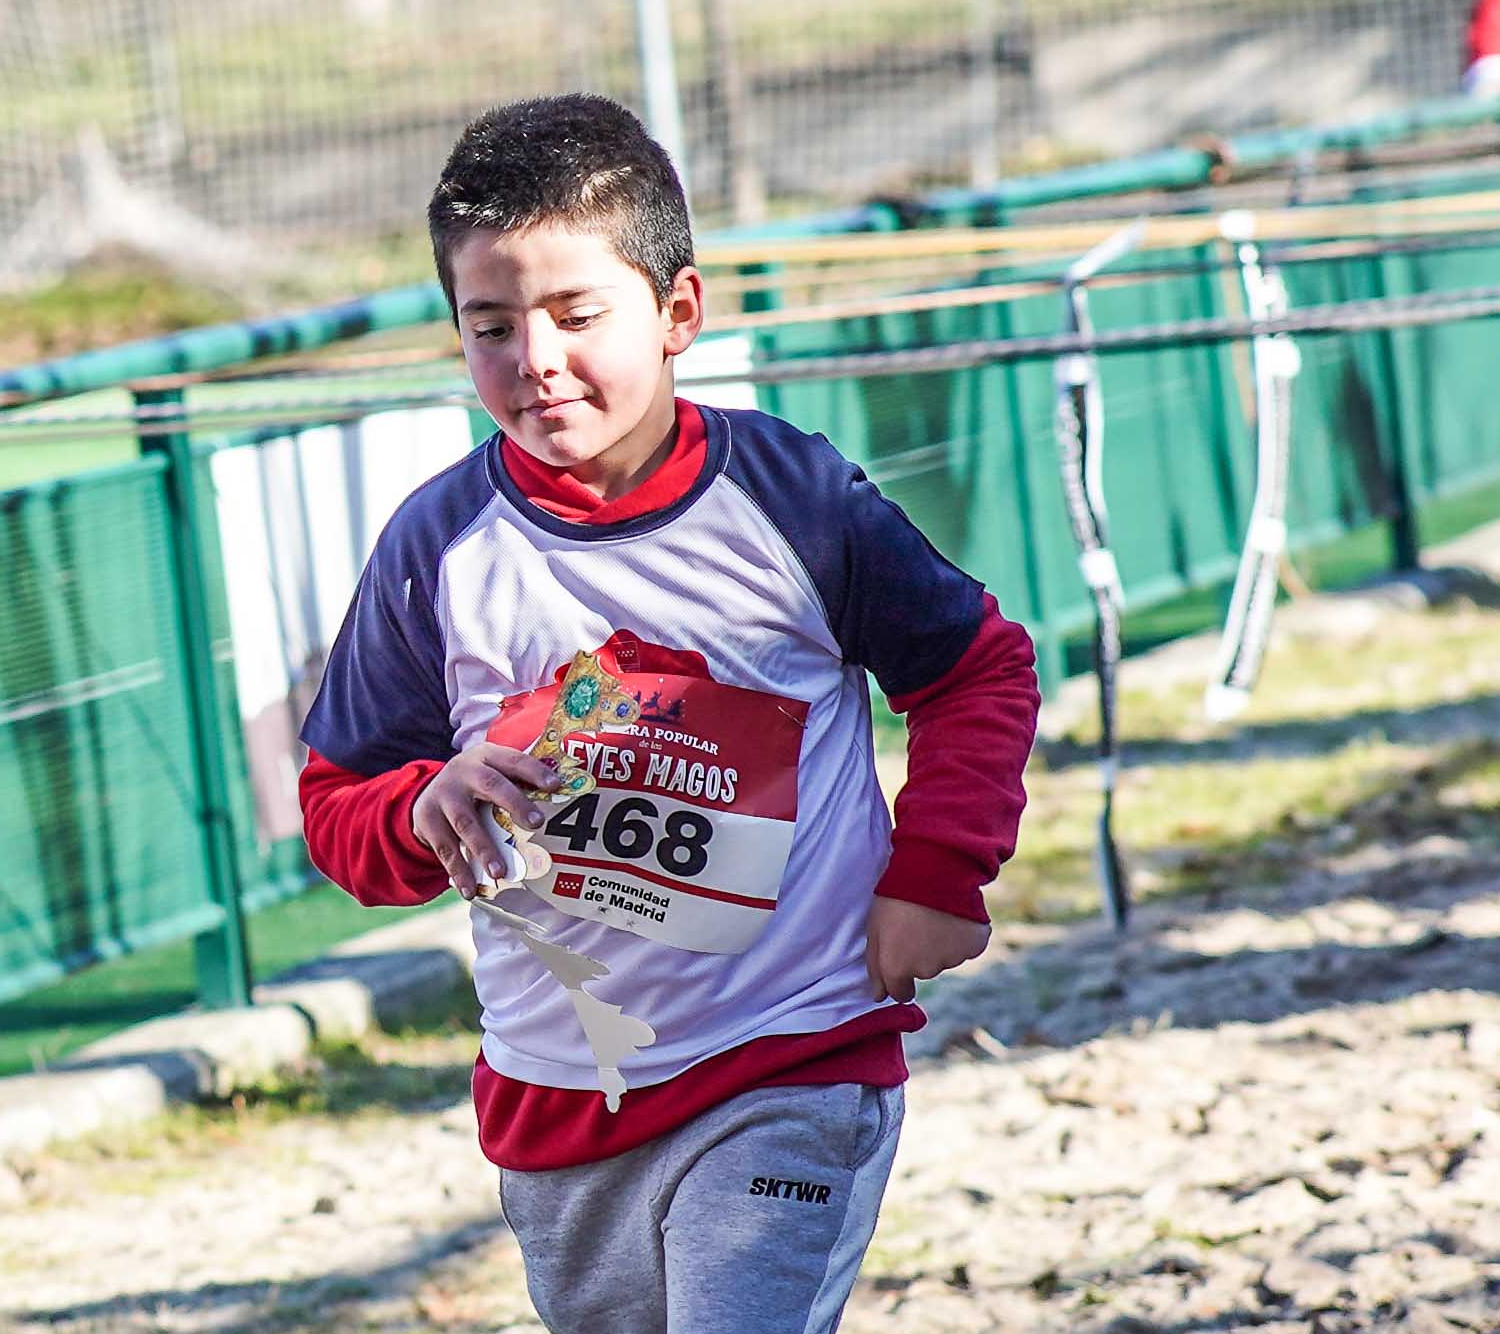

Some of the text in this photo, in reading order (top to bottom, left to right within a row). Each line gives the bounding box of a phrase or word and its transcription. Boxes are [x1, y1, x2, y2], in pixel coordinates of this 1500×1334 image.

[654, 727, 719, 756] POPULAR
[566, 739, 738, 804] EYES MAGOS
[544, 793, 714, 877] 468
[584, 889, 666, 924] de Madrid
[588, 876, 670, 909] Comunidad
[749, 1177, 832, 1205] SKTWR
